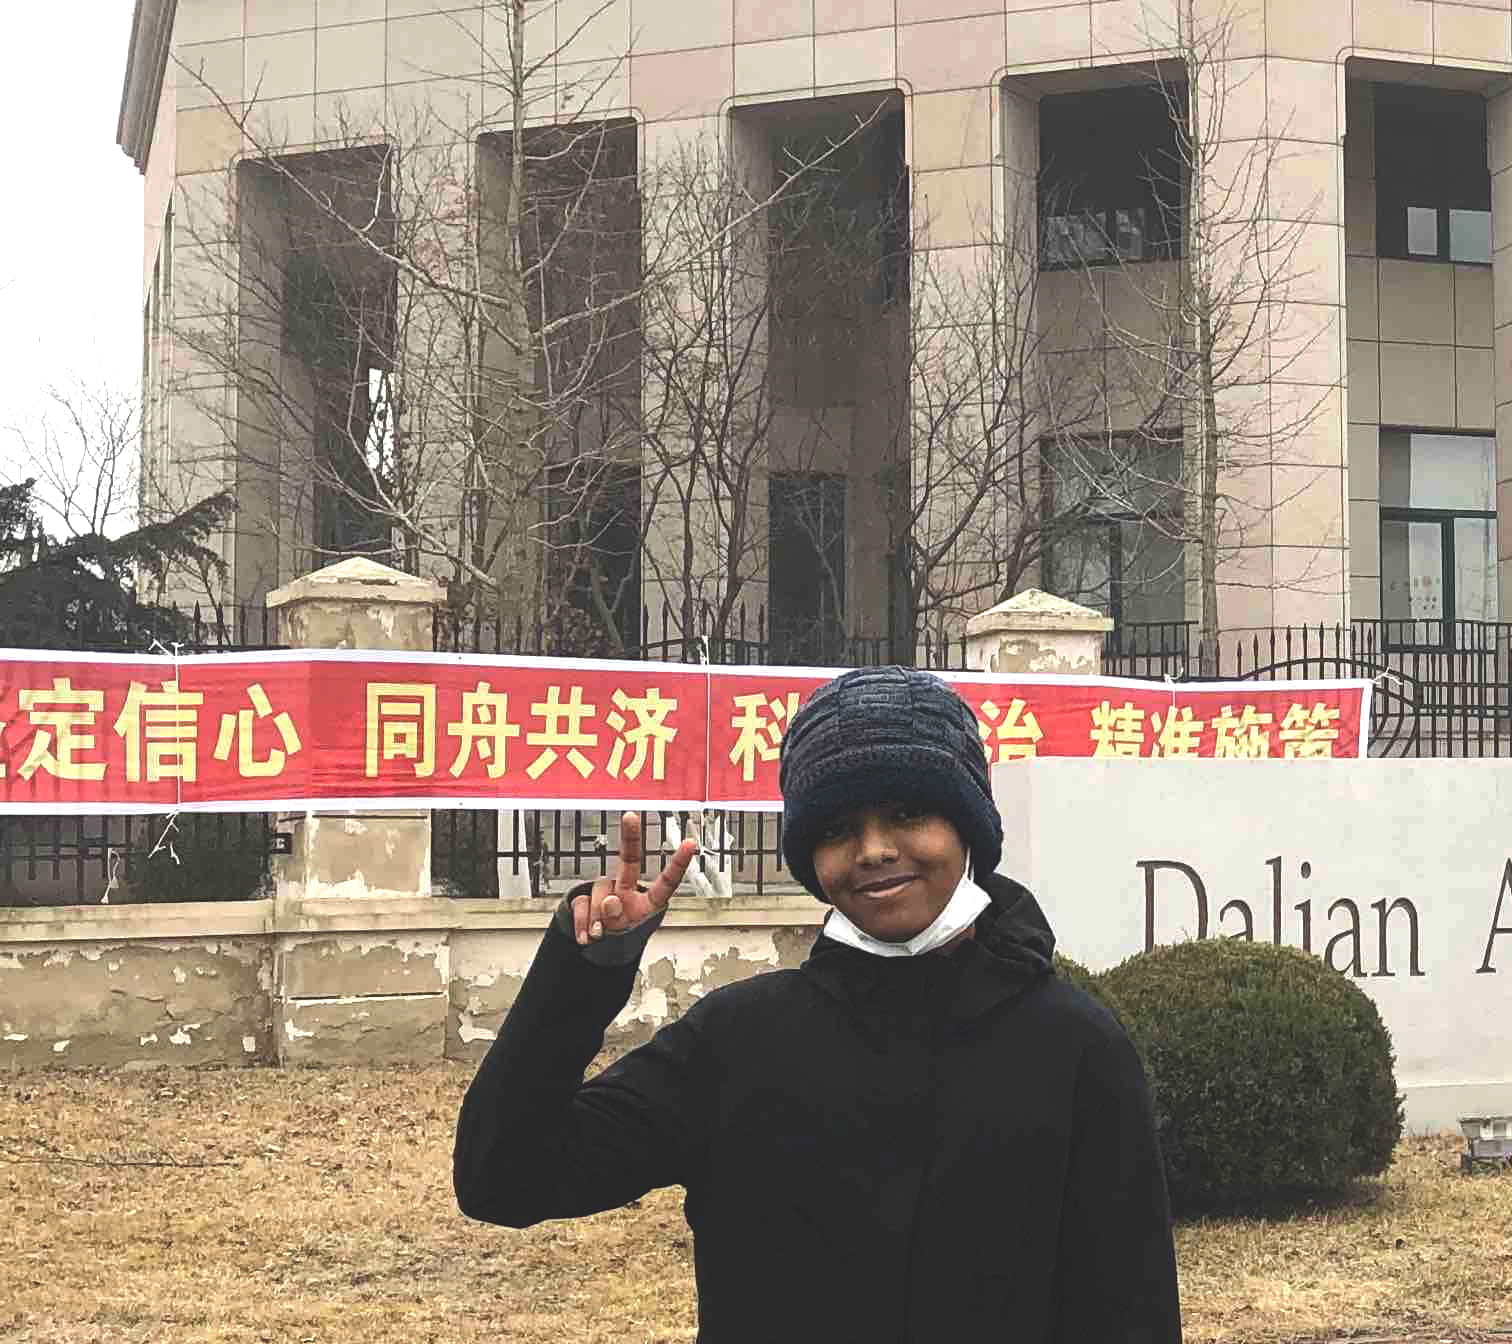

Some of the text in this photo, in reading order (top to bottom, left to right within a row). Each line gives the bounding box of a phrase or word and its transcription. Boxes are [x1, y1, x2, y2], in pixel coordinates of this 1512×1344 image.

[0, 677, 302, 783] 定信心
[364, 681, 679, 781] 同舟共济
[729, 692, 1044, 783] 科治
[1136, 855, 1426, 977] Dalian
